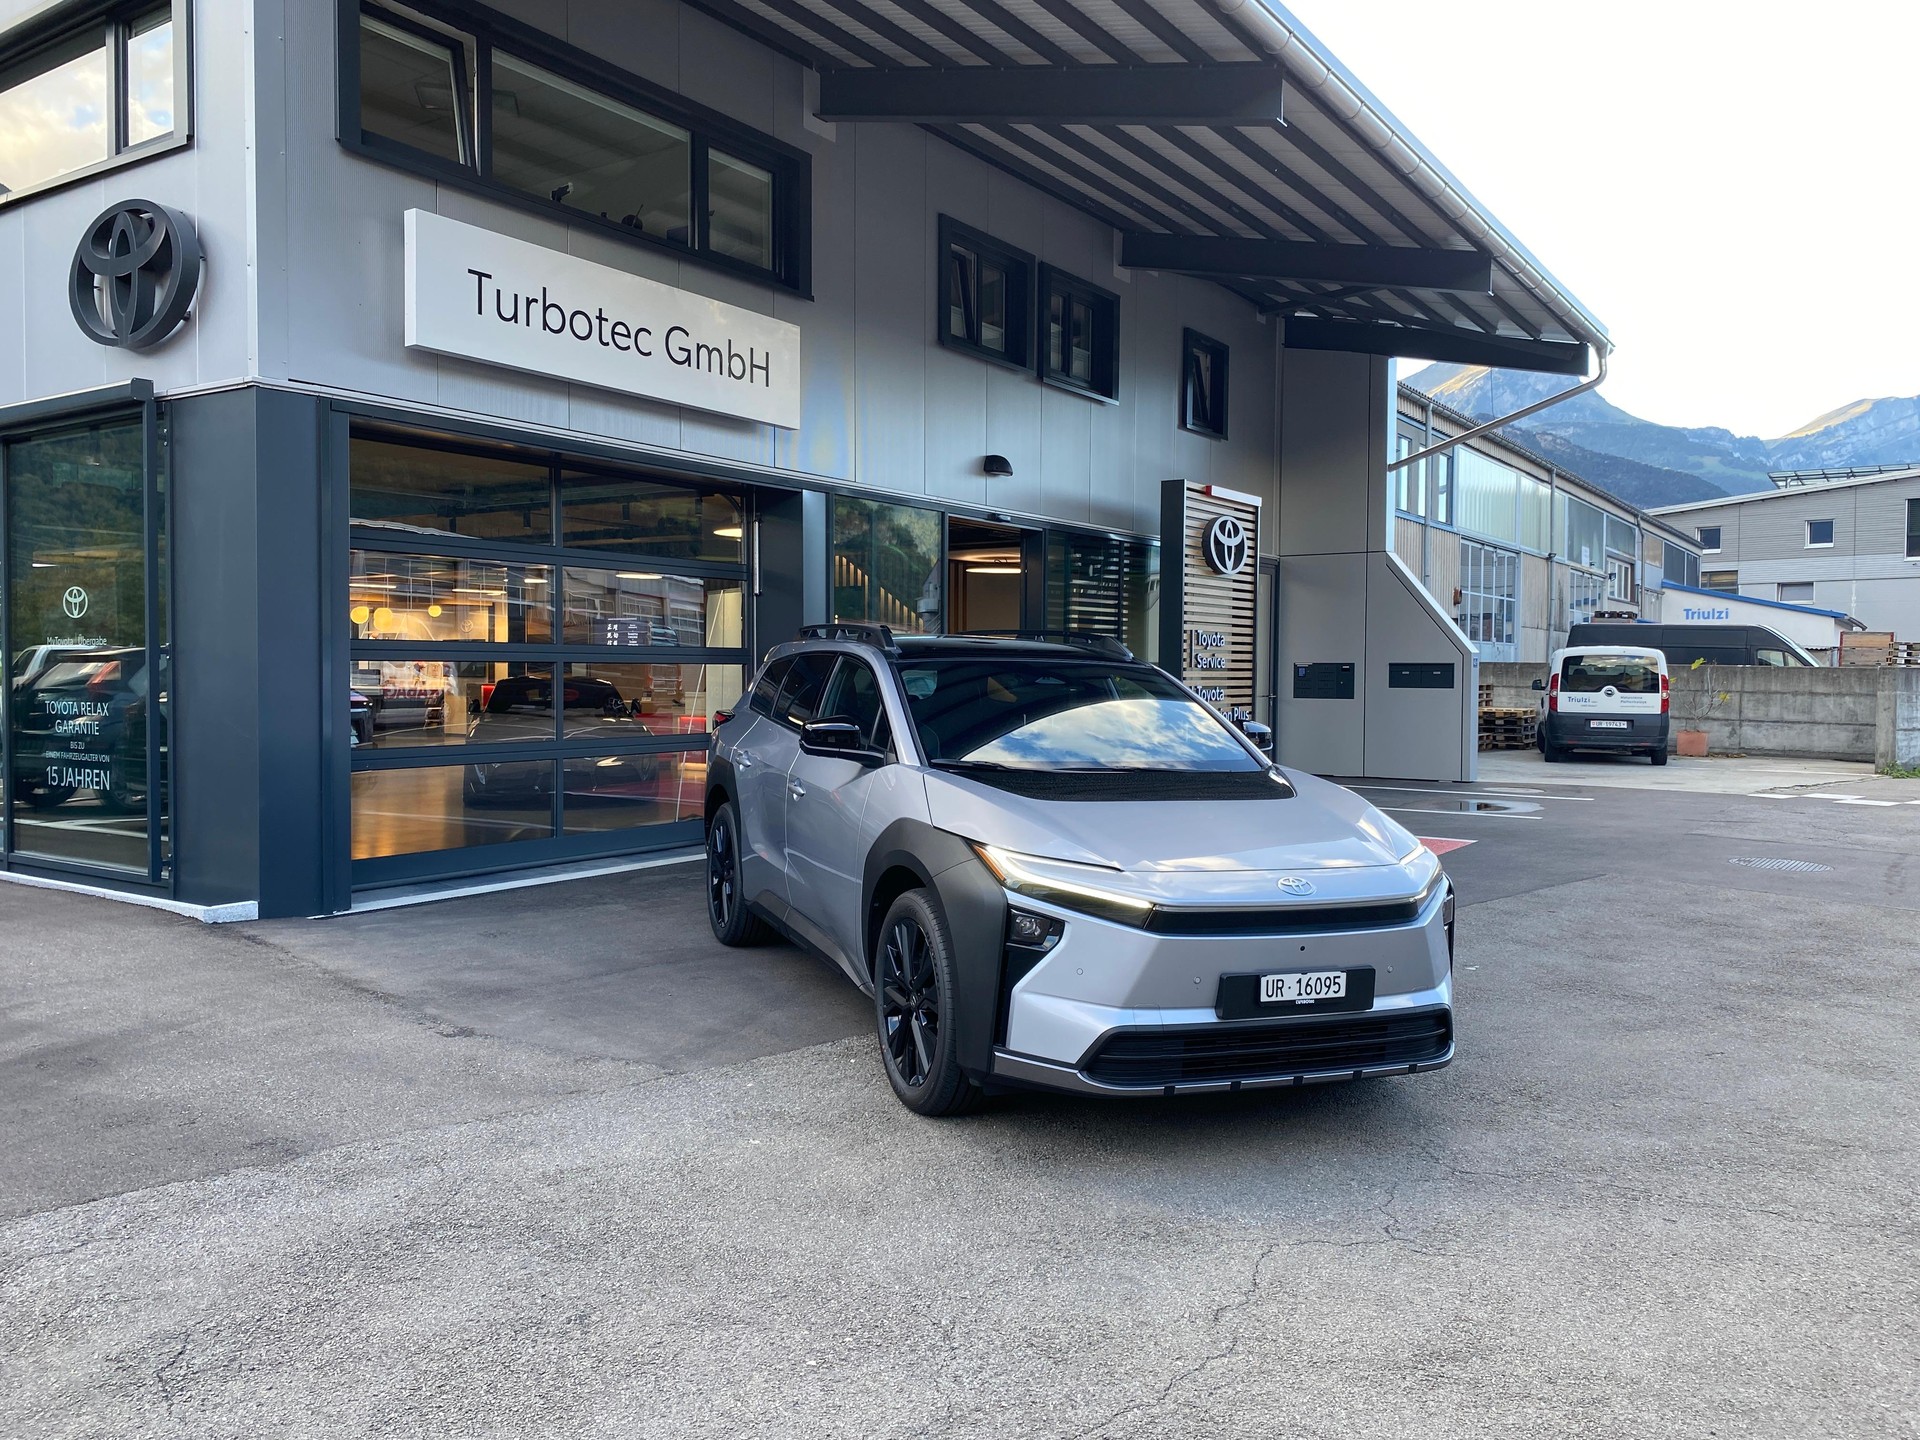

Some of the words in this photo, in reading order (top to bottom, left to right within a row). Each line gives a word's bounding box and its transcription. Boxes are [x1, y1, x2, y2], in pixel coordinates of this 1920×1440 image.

[467, 268, 652, 357] Turbotec
[664, 325, 770, 388] GmbH
[1683, 608, 1729, 620] Triulzi
[1198, 630, 1225, 649] Toyota
[1197, 654, 1225, 668] Service
[1197, 686, 1225, 702] Toyota
[45, 700, 79, 715] TOYOTA
[80, 702, 109, 717] RELAX
[1234, 706, 1250, 720] Plus
[55, 720, 100, 735] GARANTIE
[70, 741, 78, 749] BIS
[78, 742, 85, 750] ZU
[45, 751, 60, 759] EINEM
[60, 752, 99, 762] FAHRZEUGALTER
[46, 765, 58, 786] 15
[60, 767, 110, 791] JAHREN
